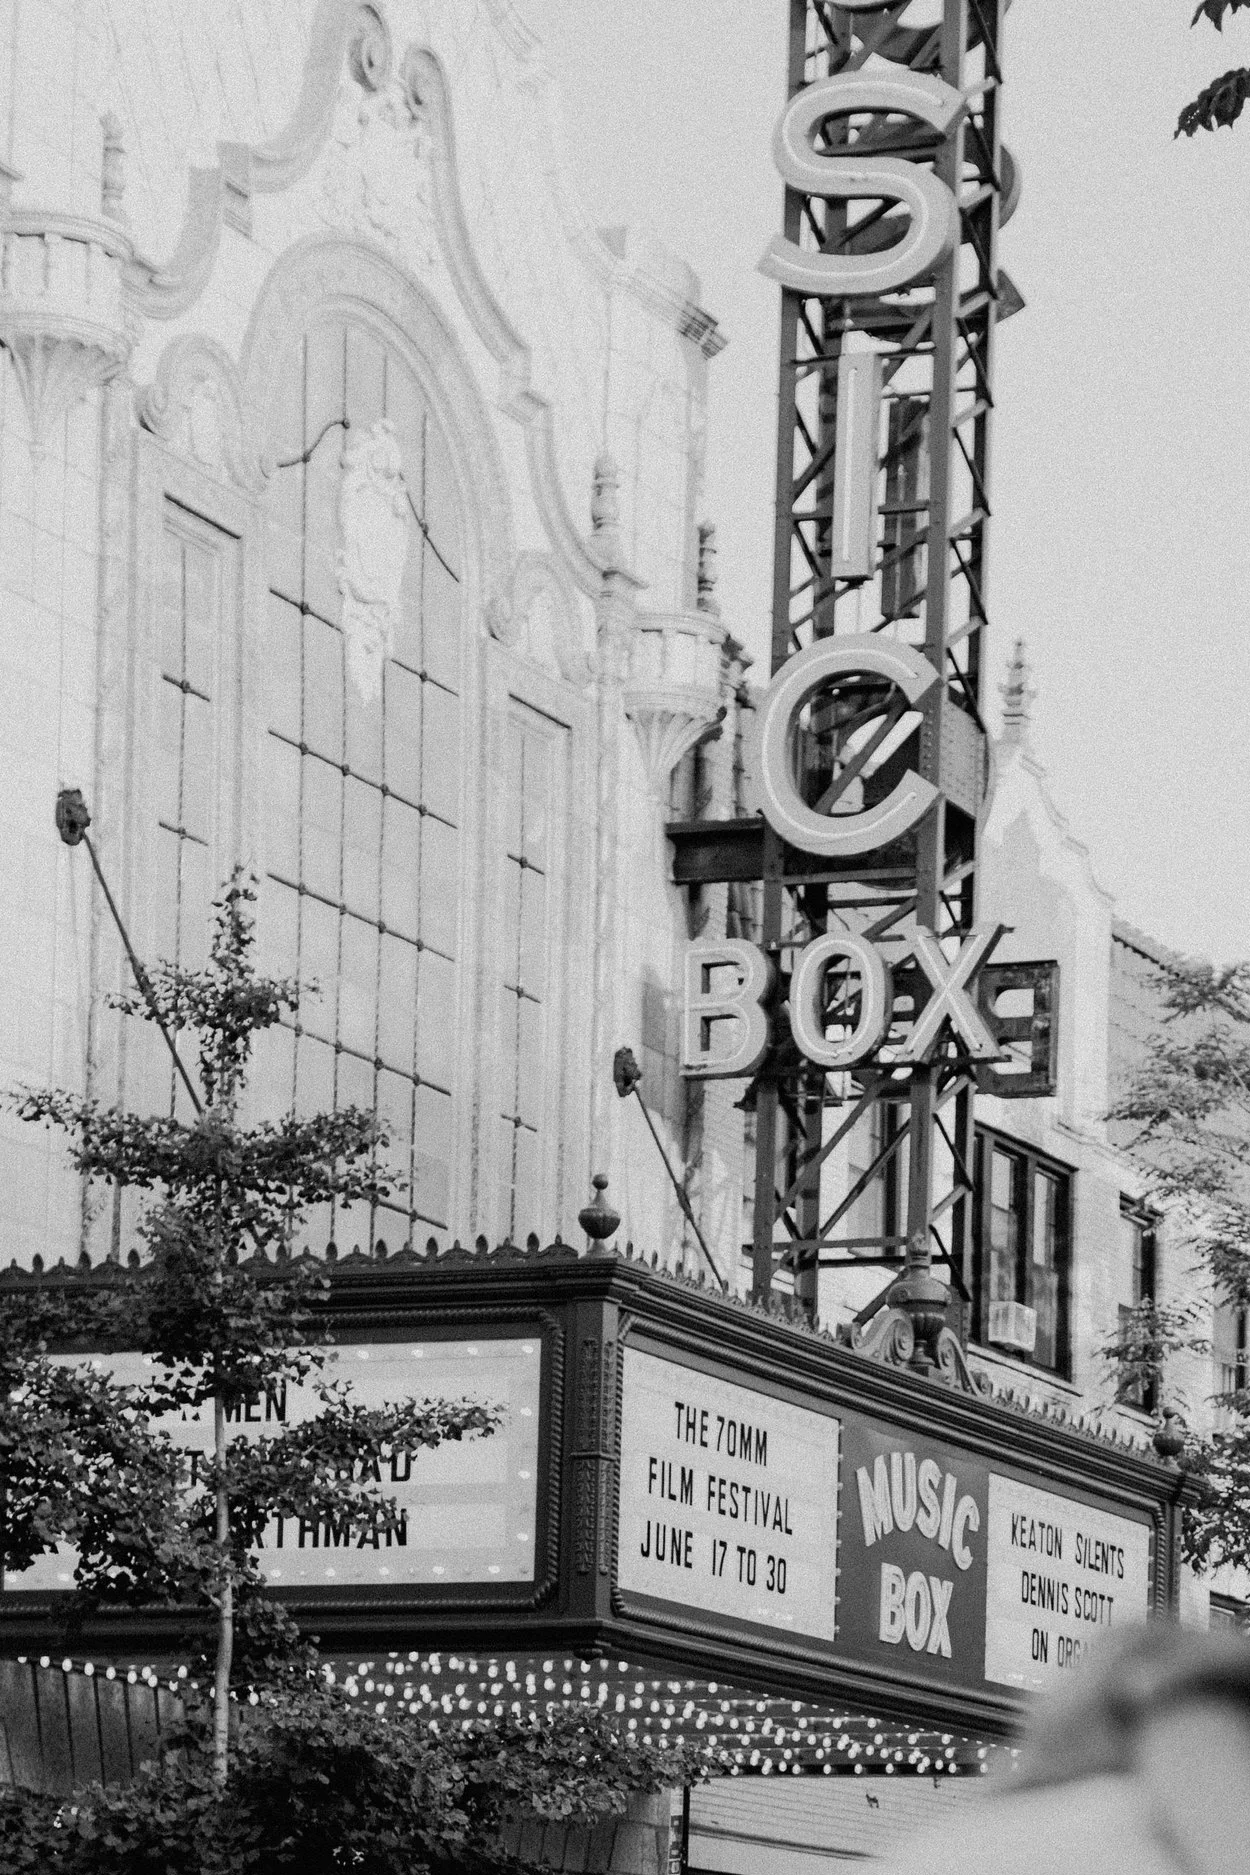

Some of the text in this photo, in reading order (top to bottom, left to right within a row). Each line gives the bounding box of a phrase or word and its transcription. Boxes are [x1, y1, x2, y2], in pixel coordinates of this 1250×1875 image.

[755, 0, 966, 857] SIC
[680, 925, 1013, 1076] BOX
[675, 1401, 768, 1467] THE 70MM
[648, 1456, 793, 1537] FILM FESTIVAL
[855, 1452, 981, 1571] MUSIC
[640, 1520, 788, 1596] JUNE 17 TO 30
[1011, 1512, 1125, 1580] KEATON SILENTS
[879, 1562, 953, 1658] BOX
[1021, 1570, 1114, 1627] DENNIS SCOTT
[1032, 1627, 1089, 1669] ON ORG
